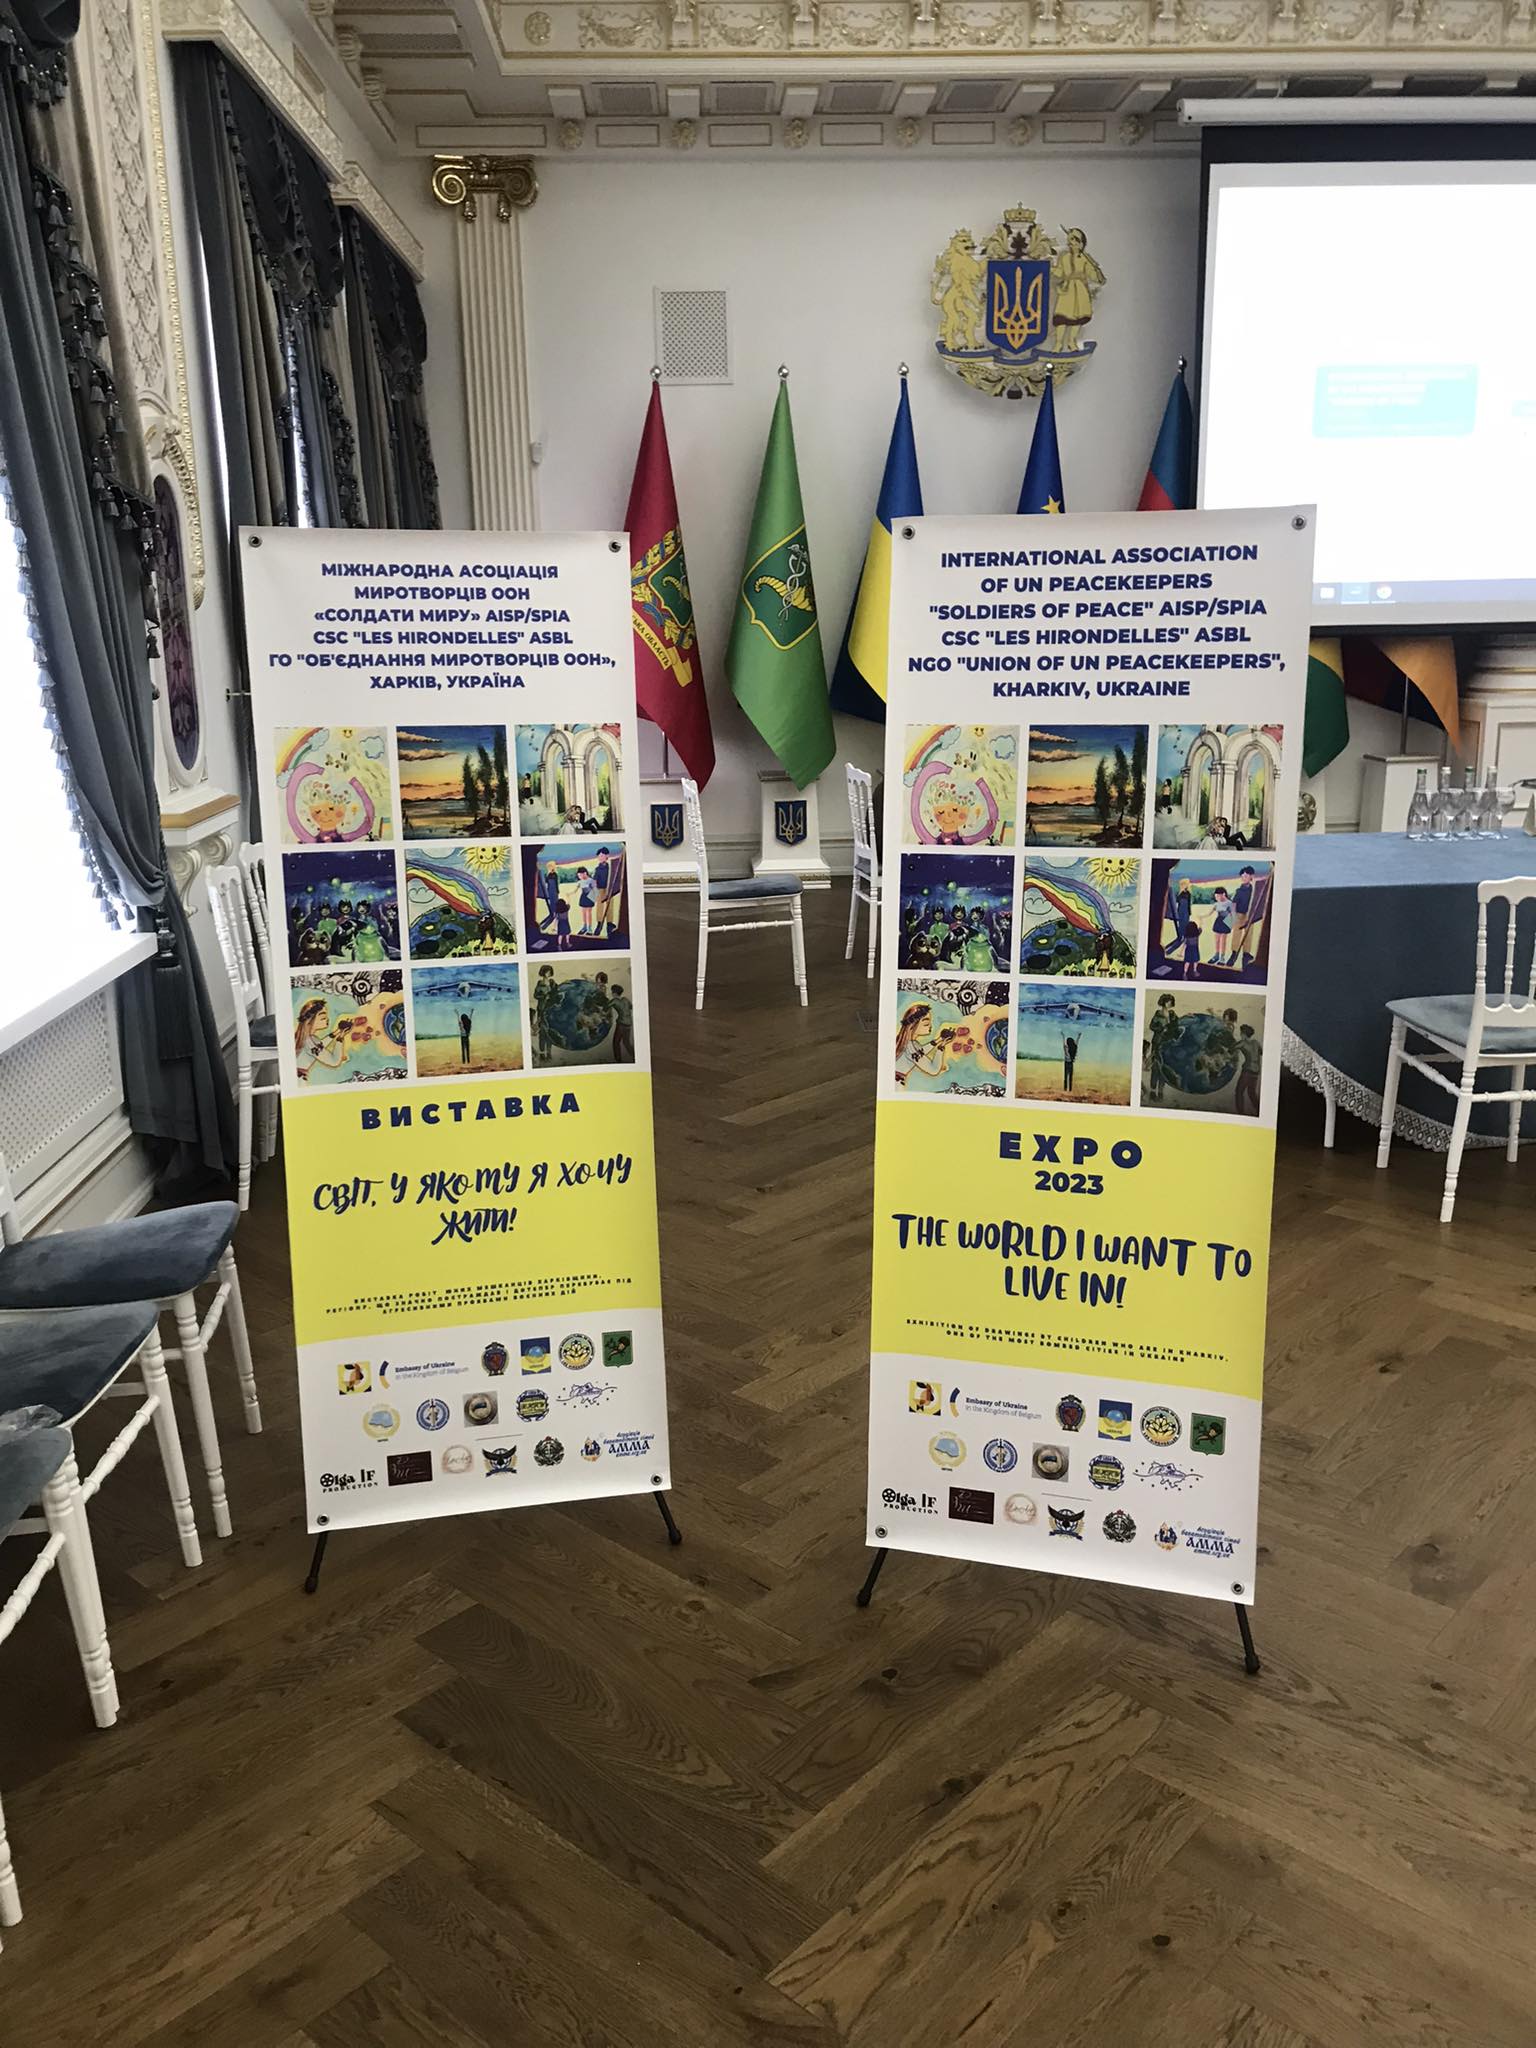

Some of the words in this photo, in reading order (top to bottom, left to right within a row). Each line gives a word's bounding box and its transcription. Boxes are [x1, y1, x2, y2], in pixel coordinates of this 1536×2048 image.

[942, 550, 1106, 567] INTERNATIONAL
[1112, 546, 1257, 563] ASSOCIATION
[322, 564, 453, 579] МІЖНАРОДНА
[460, 565, 557, 579] АСОЦІАЦІЯ
[981, 578, 1008, 593] OF
[1015, 578, 1042, 592] UN
[1050, 573, 1212, 591] PEACEKEEPERS
[355, 587, 486, 601] МИРОТВОРЦІВ
[492, 588, 529, 599] ООН
[315, 609, 413, 623] «СОЛДАТИ
[420, 610, 480, 621] МИРУ»
[486, 608, 569, 623] AISP/SPIA
[930, 604, 1035, 619] "SOLDIERS
[1042, 604, 1069, 618] OF
[1076, 602, 1153, 617] PEACE"
[1159, 598, 1266, 617] AISP/SPIA
[314, 631, 348, 644] CSC
[354, 632, 392, 644] "LES
[398, 632, 524, 644] HIRONDELLES"
[530, 632, 573, 643] ASBL
[942, 631, 979, 645] CSC
[986, 630, 1030, 645] "LES
[1037, 628, 1188, 644] HIRONDELLES"
[1195, 627, 1250, 642] ASBL
[270, 654, 291, 666] ГО
[298, 654, 425, 668] "ОБ'ЄДНАННЯ
[431, 654, 559, 667] МИРОТВОРЦІВ
[564, 654, 615, 667] ООН»,
[909, 657, 951, 671] NGO
[958, 657, 1030, 671] "UNION
[1037, 656, 1064, 670] OF
[1071, 656, 1099, 670] UN
[1107, 654, 1285, 671] PEACEKEEPERS",
[371, 676, 441, 690] ХАРКІВ,
[447, 673, 524, 688] УКРАЇНА
[994, 682, 1090, 699] KHARKIV,
[1097, 681, 1190, 696] UKRAINE
[362, 1093, 579, 1129] ВИСТАВКА
[1000, 1132, 1142, 1168] EXPO
[1035, 1171, 1103, 1195] 2023
[892, 1214, 948, 1249] THE
[958, 1220, 1066, 1261] WORLD
[1077, 1230, 1084, 1260] I
[1094, 1235, 1197, 1277] WANT
[1207, 1243, 1251, 1280] TO
[1005, 1266, 1069, 1300] LIVE
[1080, 1272, 1126, 1308] IN!
